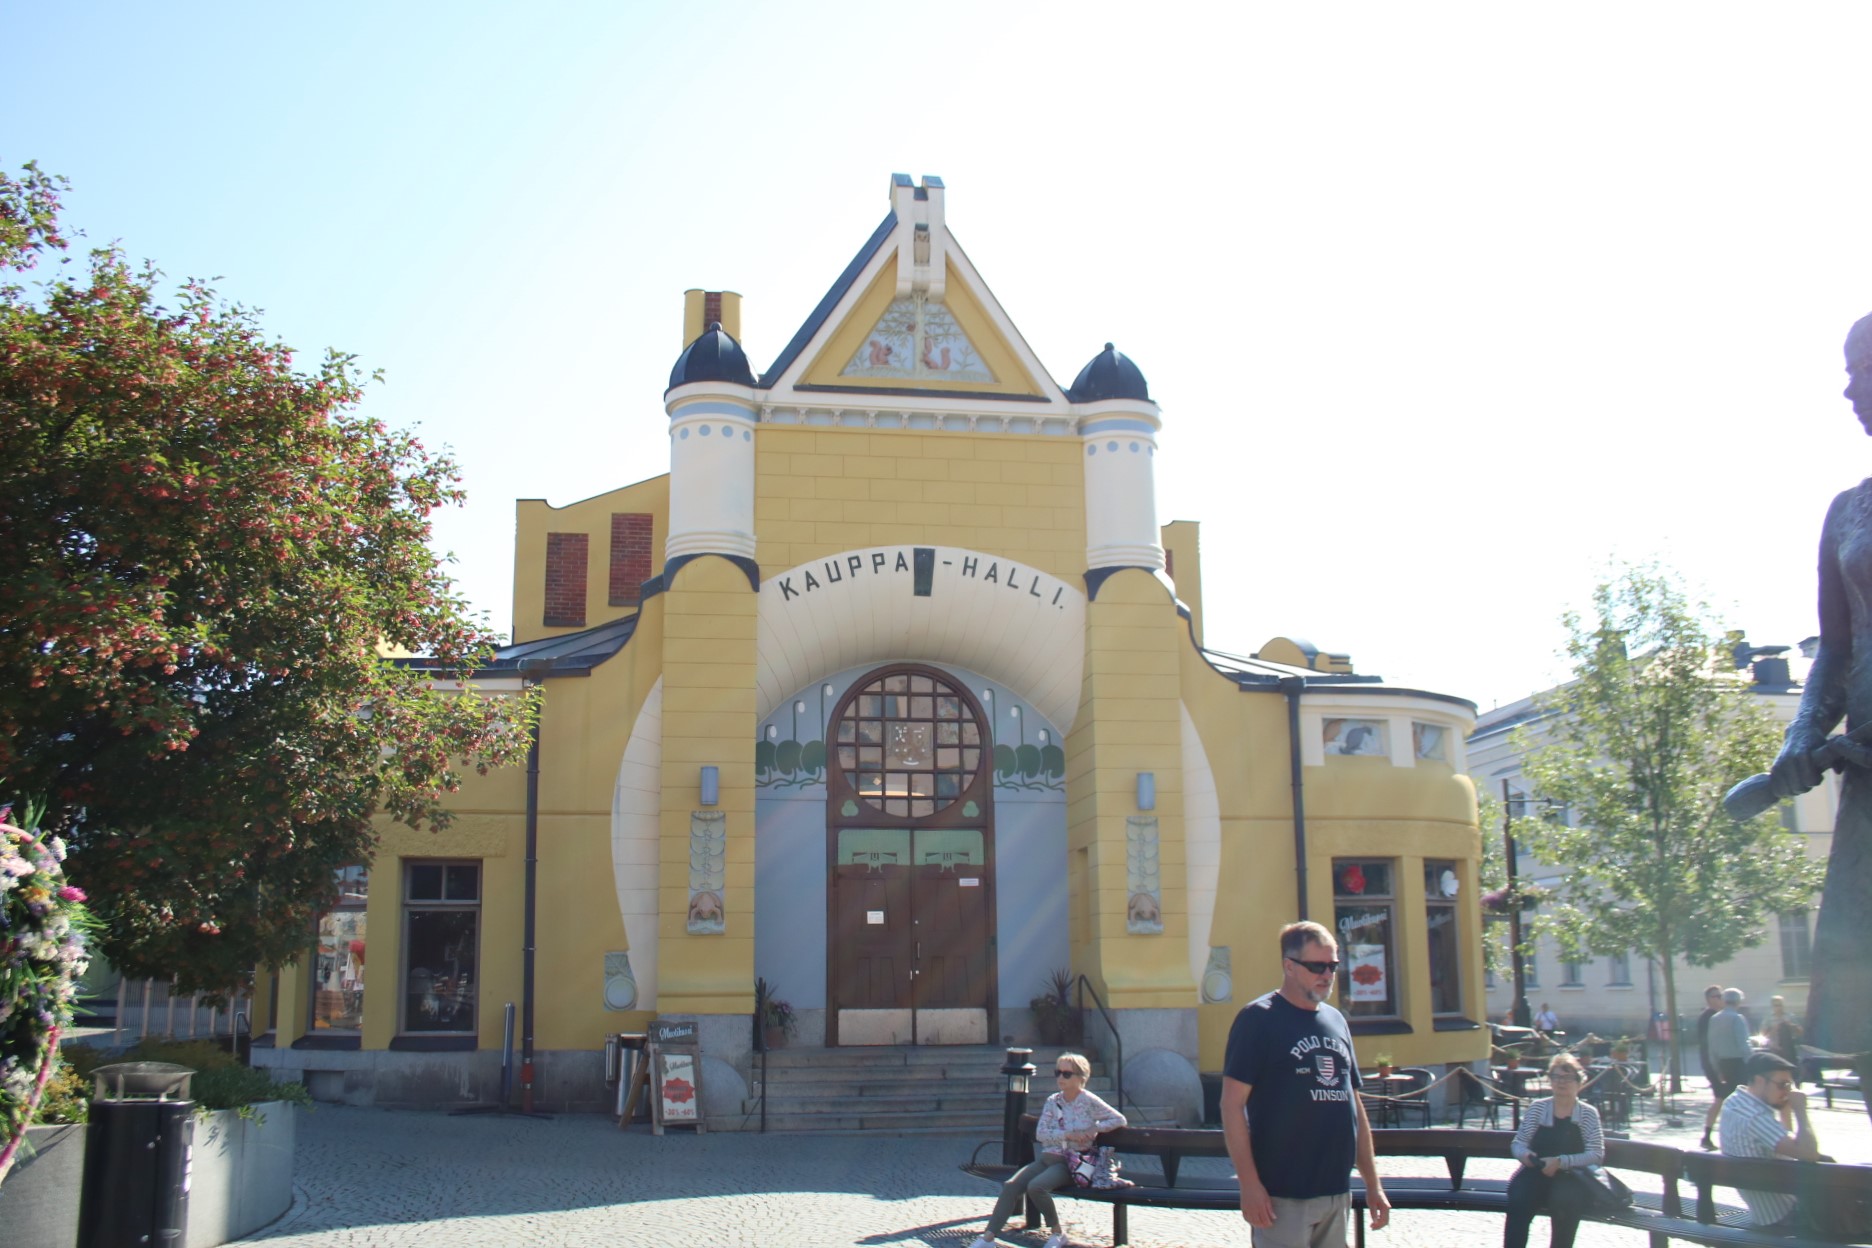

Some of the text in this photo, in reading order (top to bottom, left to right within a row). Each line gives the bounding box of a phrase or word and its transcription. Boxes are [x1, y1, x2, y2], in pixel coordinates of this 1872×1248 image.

[779, 551, 909, 600] KAUPPA
[1290, 1035, 1321, 1060] POLO
[1310, 1089, 1349, 1101] VINSON
